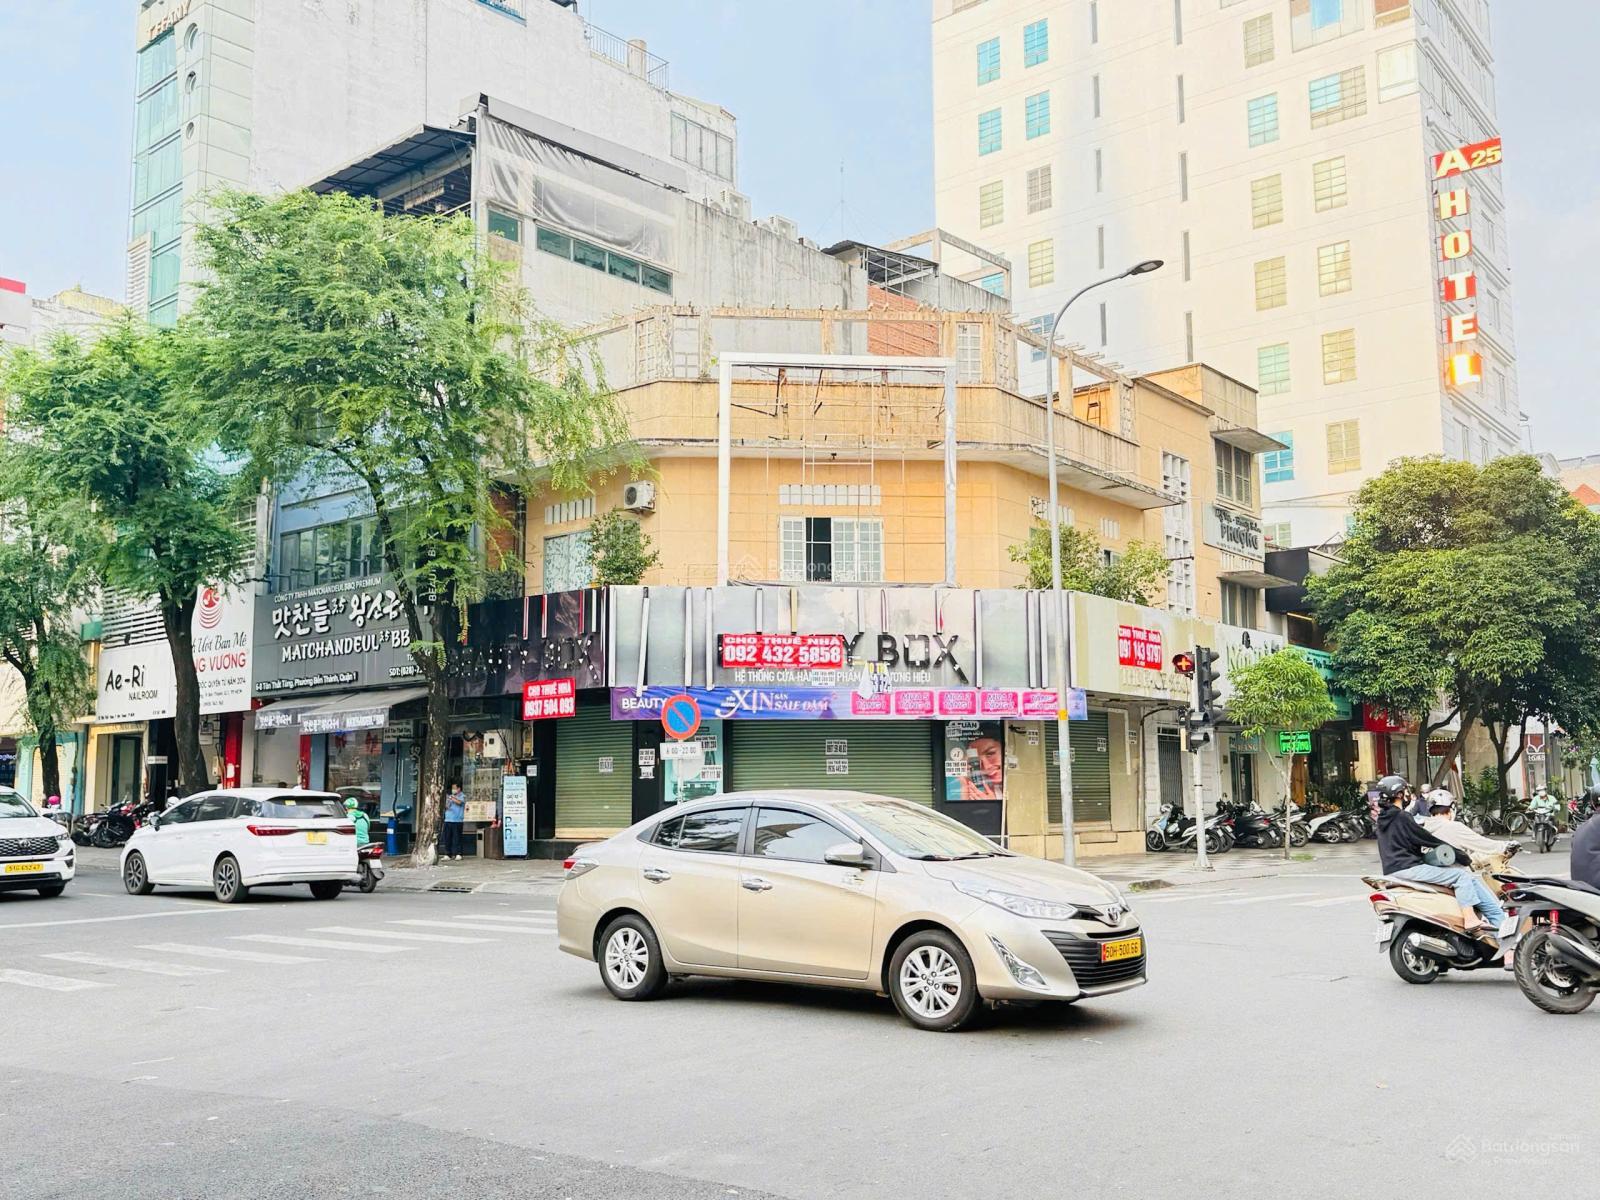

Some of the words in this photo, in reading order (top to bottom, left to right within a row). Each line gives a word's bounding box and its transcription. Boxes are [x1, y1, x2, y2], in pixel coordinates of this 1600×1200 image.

[1438, 187, 1482, 386] HOTEL
[281, 634, 380, 663] MATCHANDEUL
[391, 628, 411, 649] BB
[724, 636, 758, 645] CHO
[762, 635, 802, 645] THUÊ
[807, 636, 841, 646] NHÀ
[209, 650, 246, 671] VƯƠNG
[724, 645, 758, 662] 092
[762, 645, 795, 663] 432
[799, 645, 841, 663] 5858
[877, 633, 968, 683] BOX
[104, 664, 145, 692] Ae-Ri
[734, 669, 746, 685] HỆ
[747, 668, 775, 683] THỐNG
[912, 667, 931, 684] HIỆU
[621, 698, 668, 710] BEAUTY
[774, 700, 801, 711] SALE
